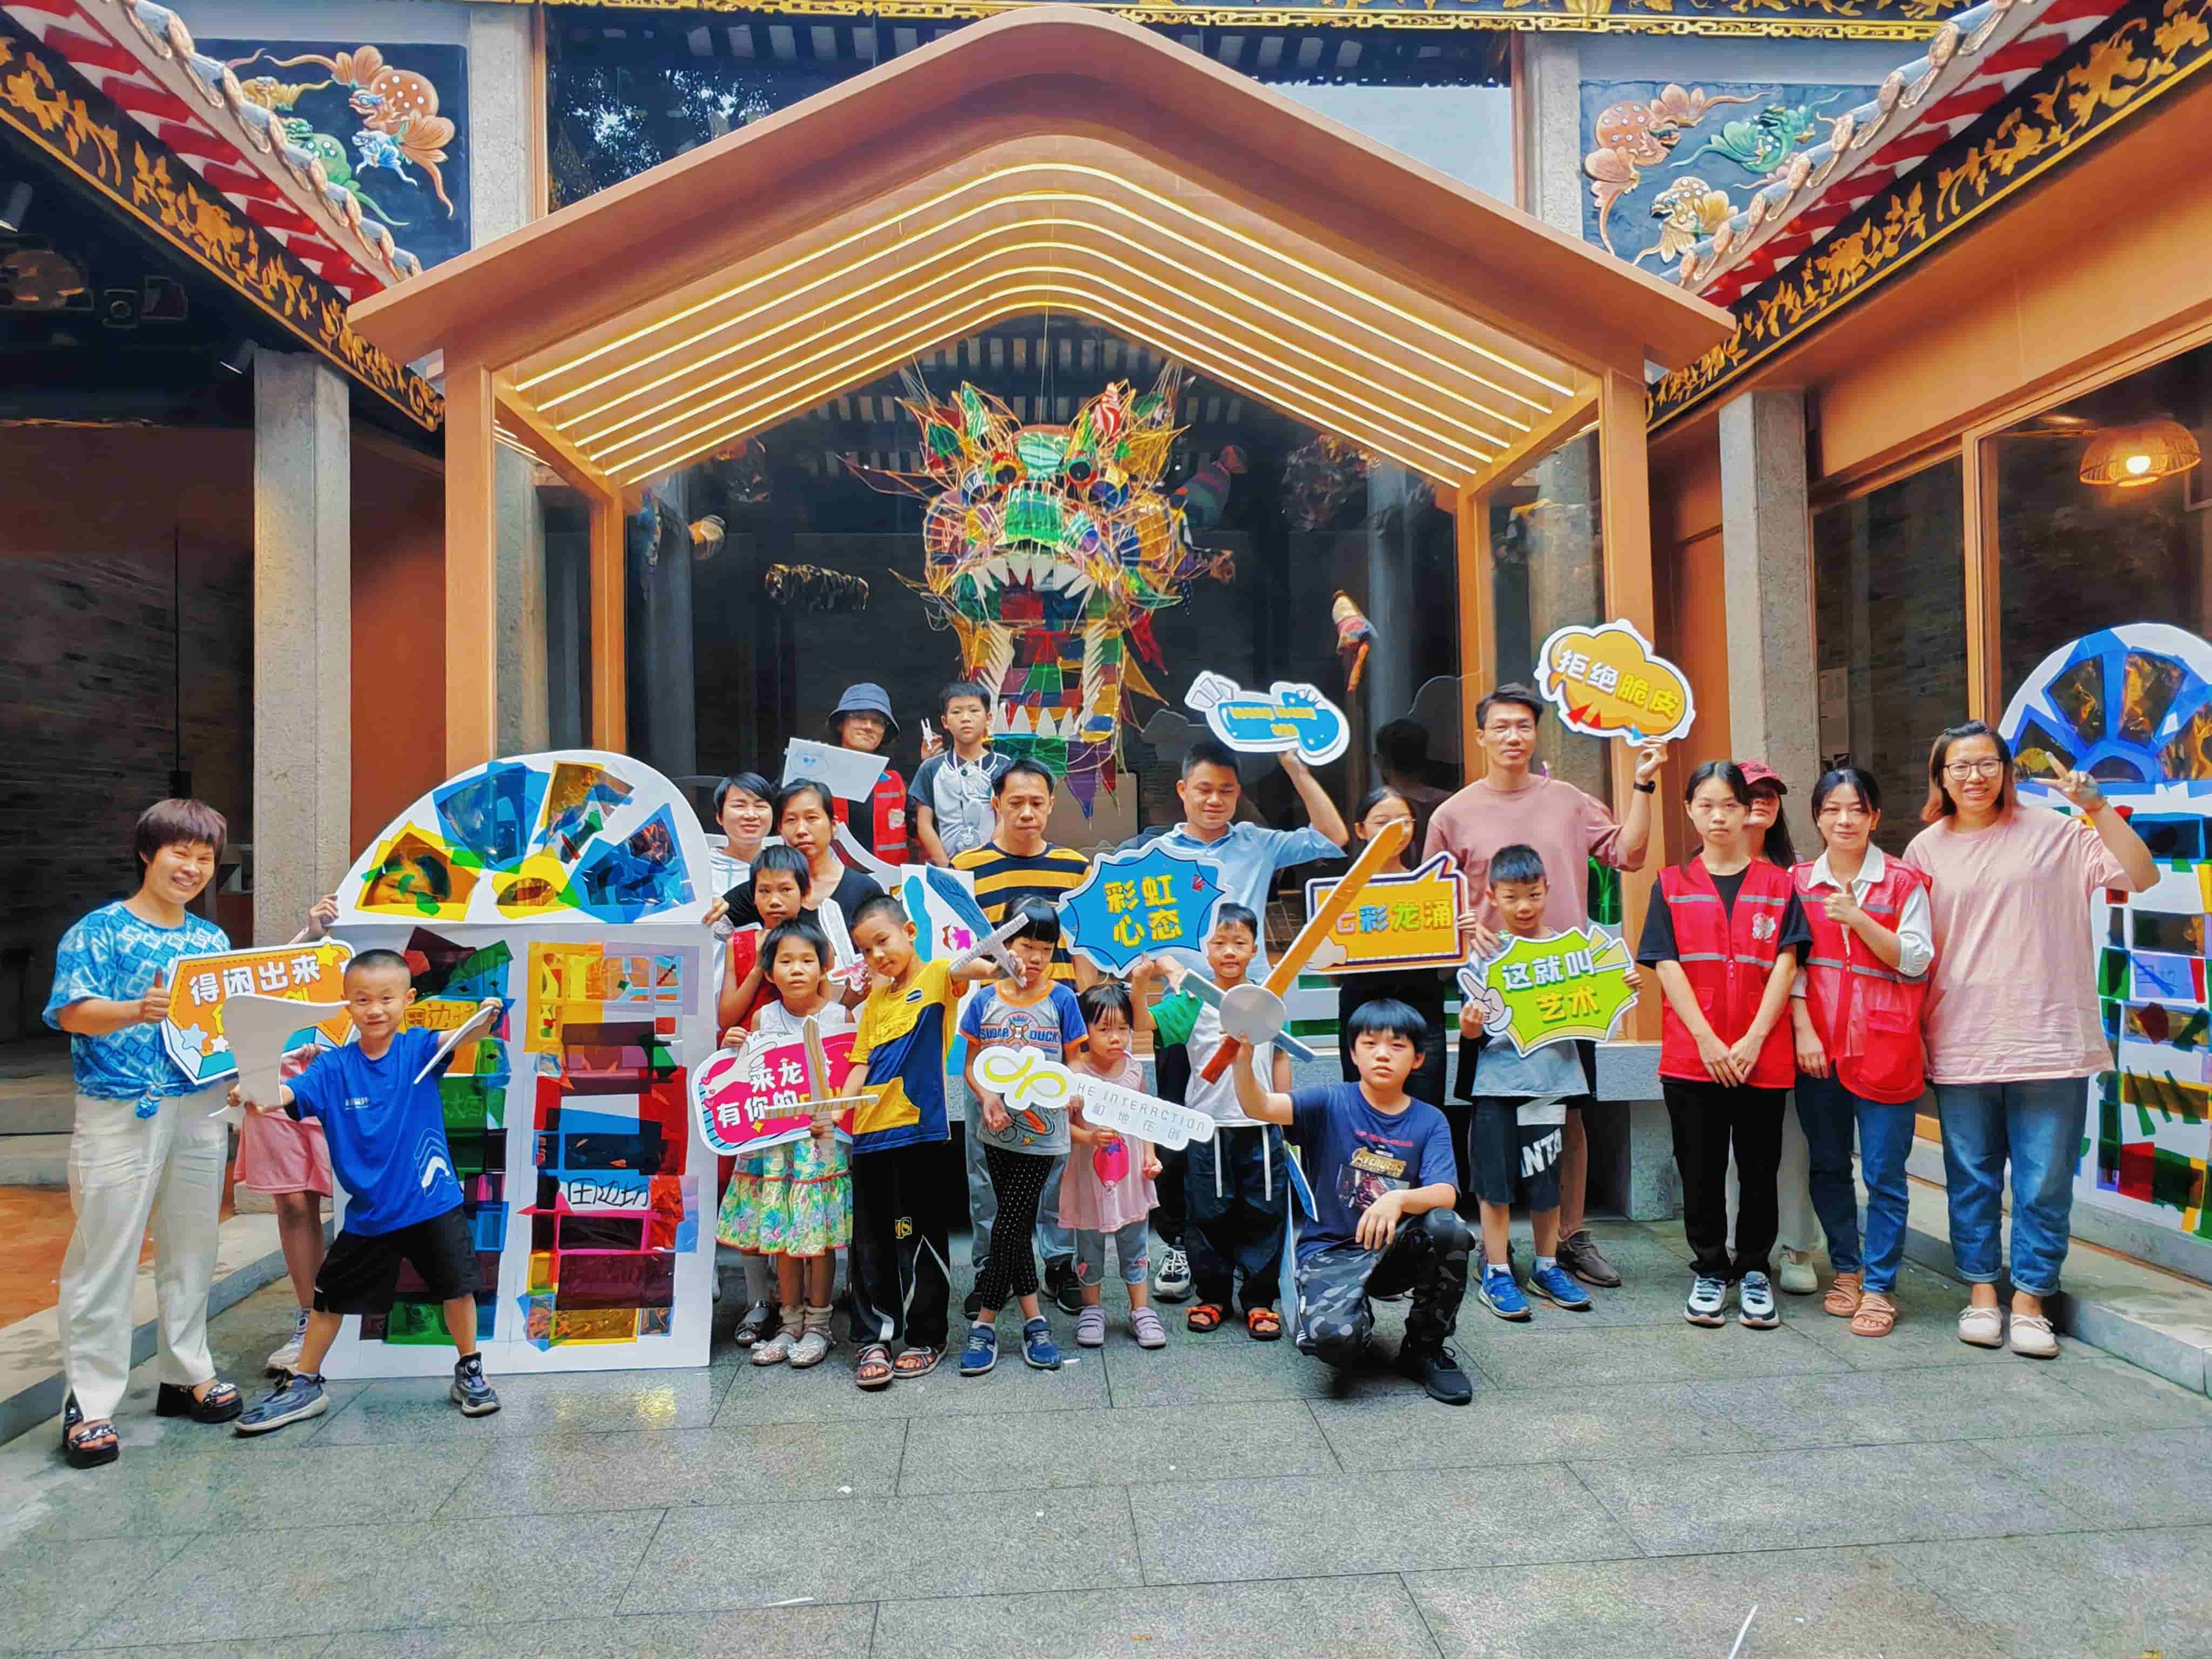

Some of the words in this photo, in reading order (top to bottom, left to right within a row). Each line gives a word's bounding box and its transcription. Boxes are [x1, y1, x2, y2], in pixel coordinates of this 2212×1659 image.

[1557, 649, 1678, 721] 拒绝脆皮
[1104, 874, 1178, 914] 彩虹
[1113, 908, 1183, 948] 心态
[189, 955, 320, 1006] 得闲出来
[1501, 948, 1595, 993] 这就叫
[1535, 984, 1600, 1023] 艺术
